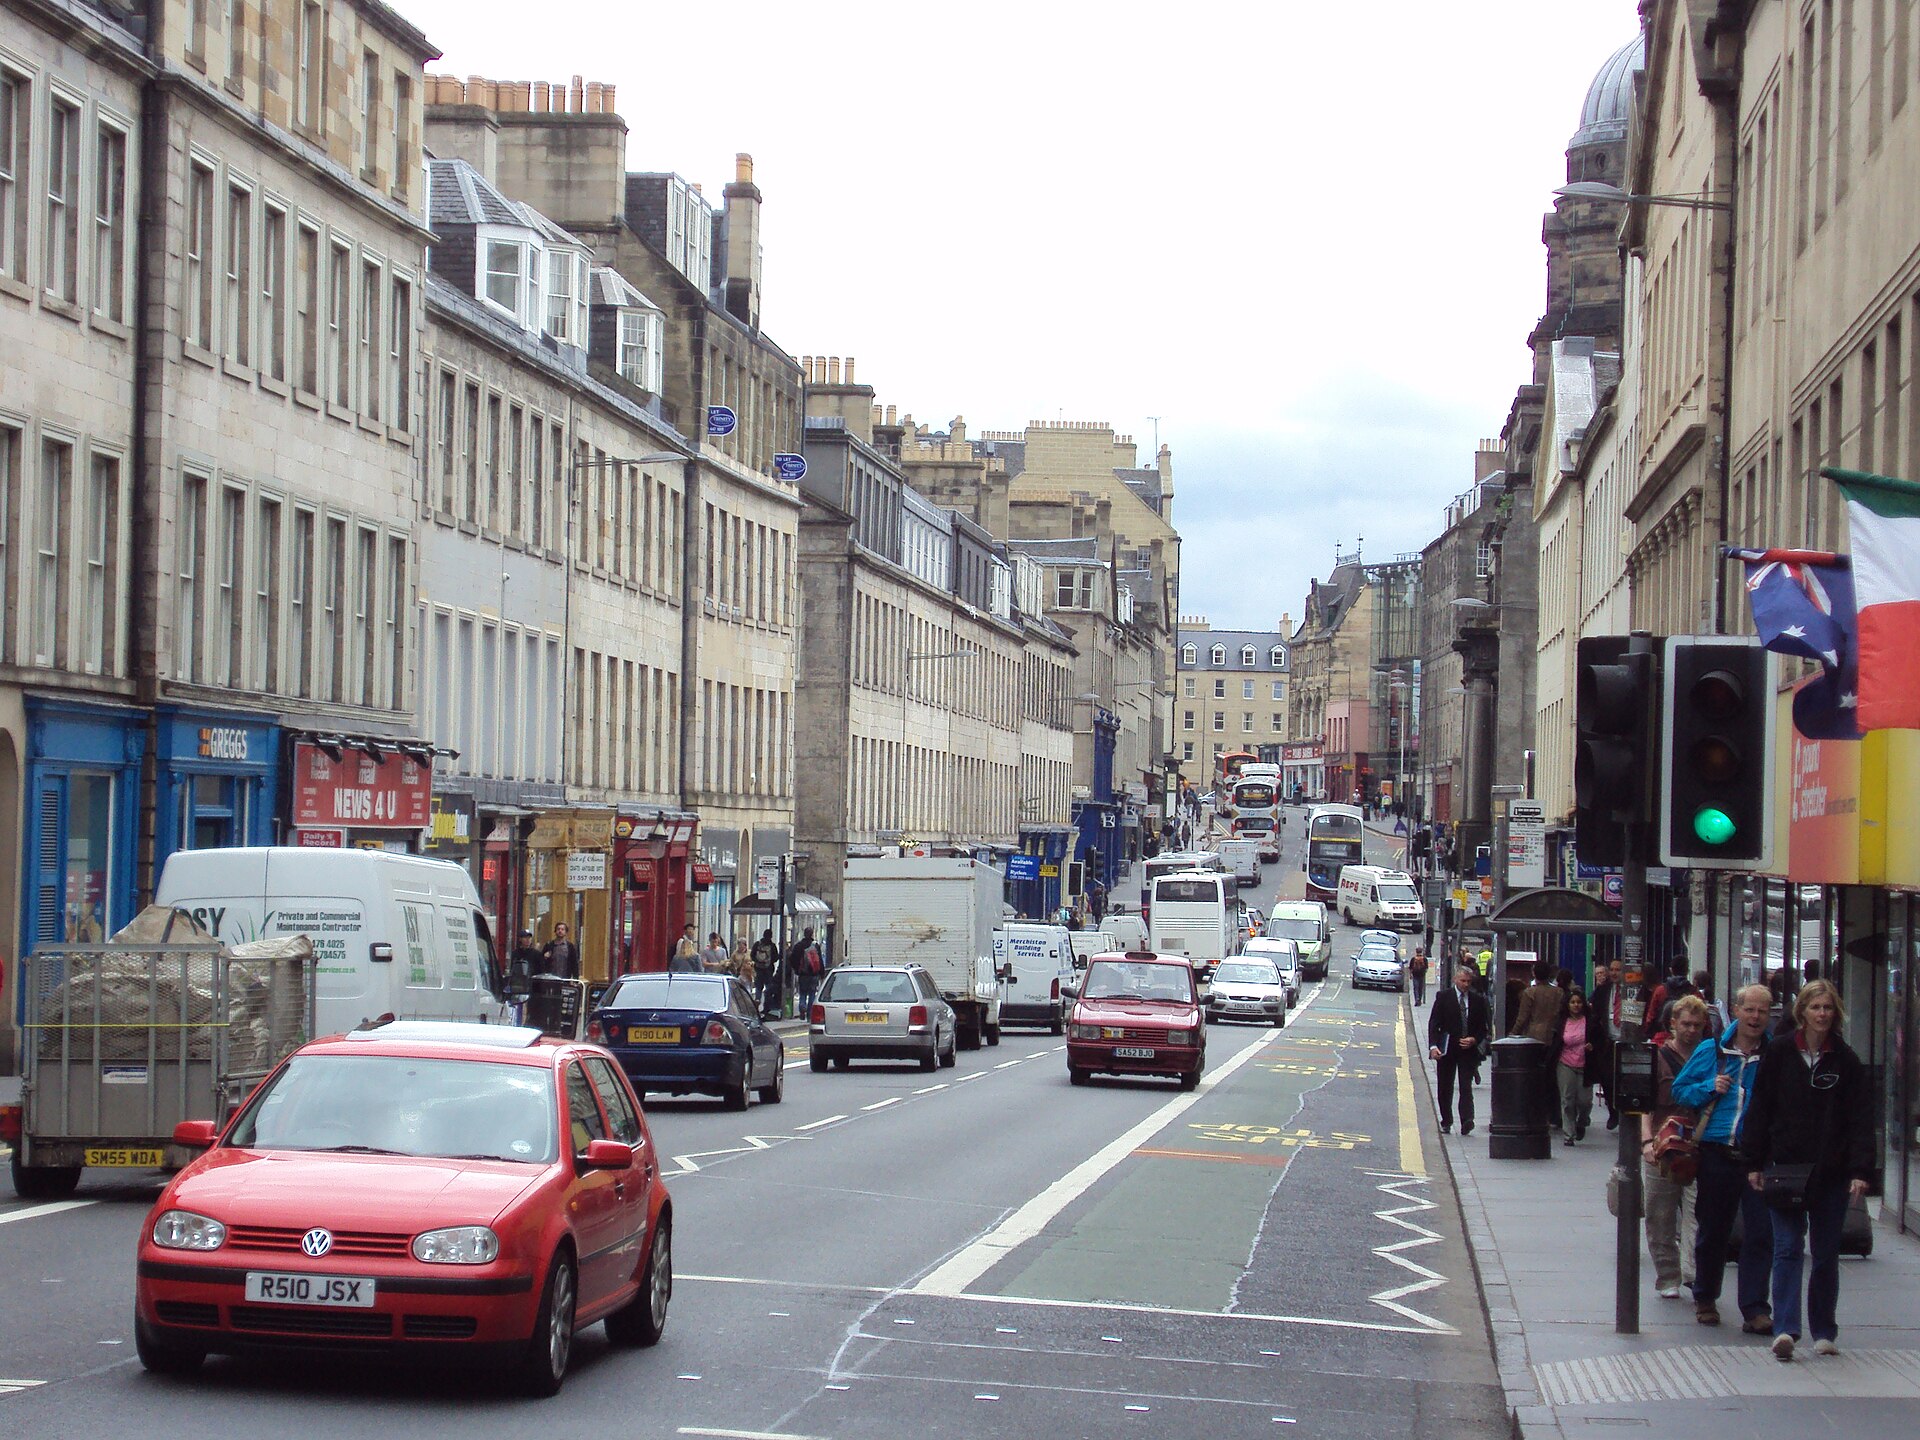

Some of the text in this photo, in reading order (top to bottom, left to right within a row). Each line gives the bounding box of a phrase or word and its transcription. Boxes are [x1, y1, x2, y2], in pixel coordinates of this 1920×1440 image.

[211, 727, 248, 760] GREGGS
[334, 788, 397, 820] NEWS 4 U
[303, 833, 325, 841] Daily
[633, 863, 650, 871] SALLY
[1580, 863, 1602, 873] News
[277, 911, 361, 921] Private and Commercial
[276, 922, 362, 932] Maintenance Contractor
[326, 939, 345, 949] 4025
[1014, 944, 1042, 952] Building
[319, 950, 347, 960] 784575
[1016, 950, 1045, 958] Services
[634, 1030, 674, 1040] C190 LAW
[1117, 1048, 1137, 1057] SA52
[1188, 1123, 1372, 1143] STOP
[1195, 1131, 1355, 1150] BUS
[91, 1151, 158, 1165] SM55 WDA
[260, 1276, 361, 1302] R510 JSX
